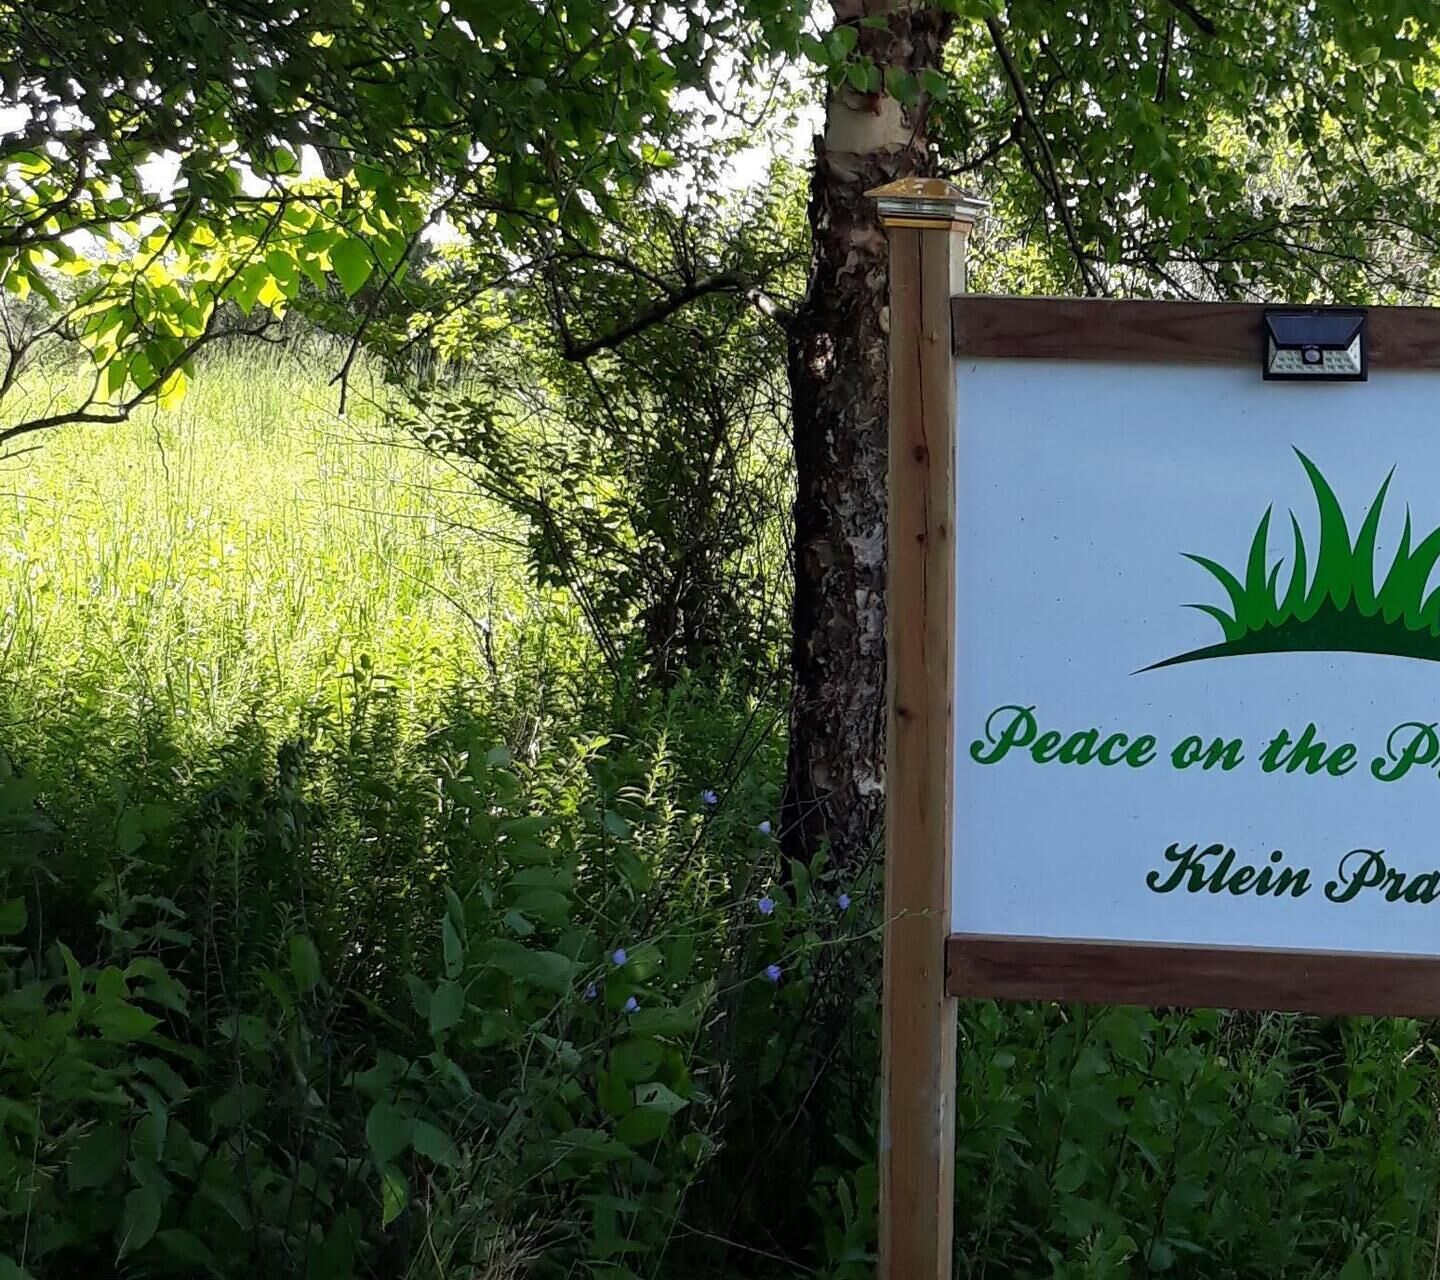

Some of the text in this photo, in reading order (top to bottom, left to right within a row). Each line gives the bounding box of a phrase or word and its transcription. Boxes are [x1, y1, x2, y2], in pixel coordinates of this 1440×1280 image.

[970, 705, 1157, 768] Peace
[1171, 735, 1244, 771] on
[1259, 723, 1357, 777] the
[1146, 843, 1311, 897] Klein
